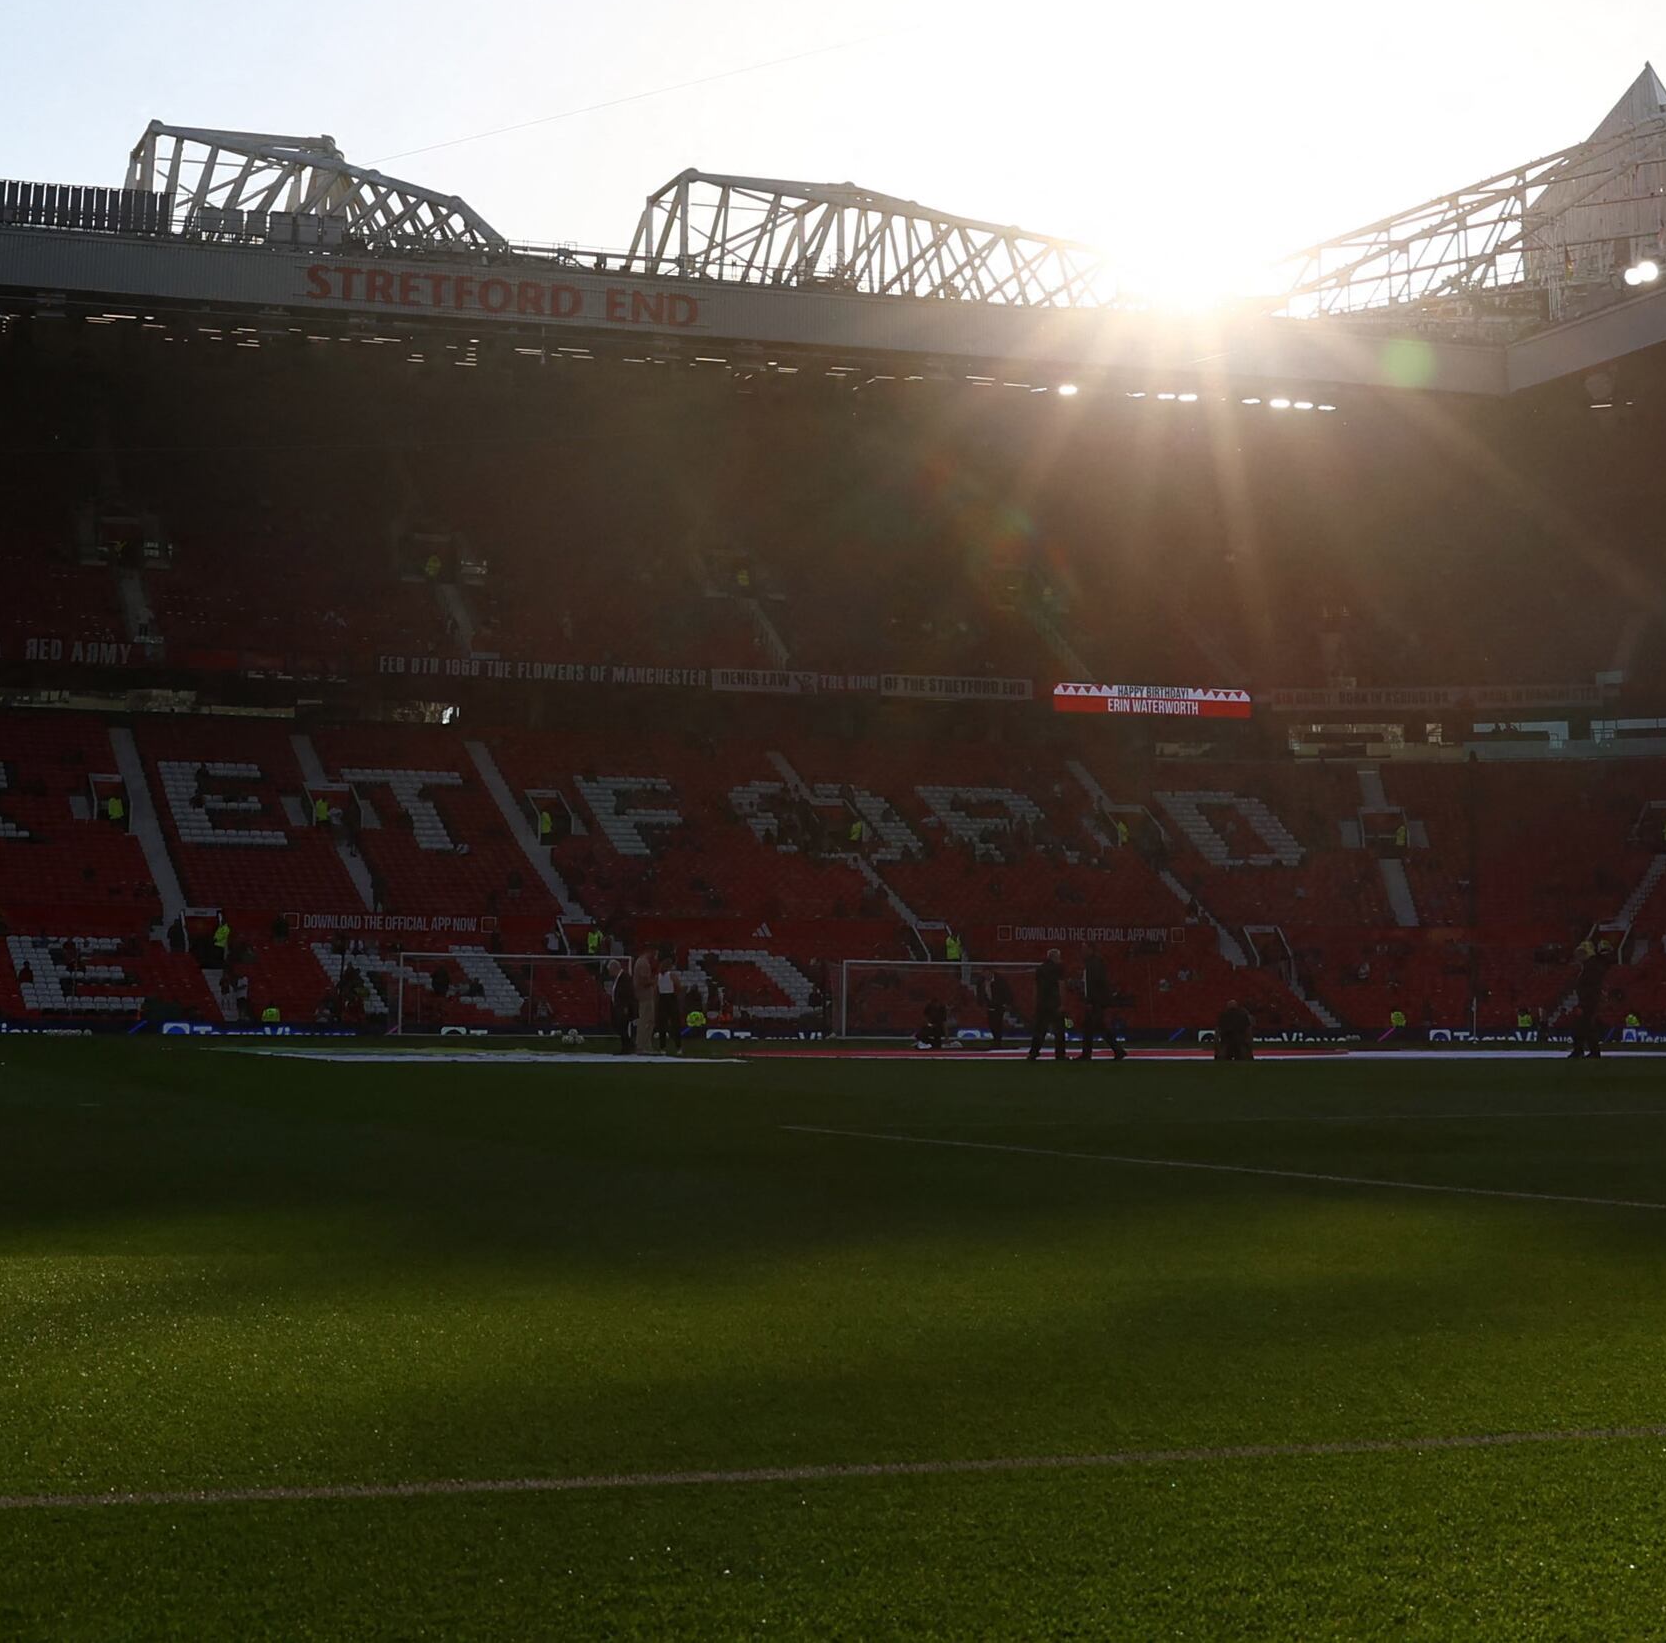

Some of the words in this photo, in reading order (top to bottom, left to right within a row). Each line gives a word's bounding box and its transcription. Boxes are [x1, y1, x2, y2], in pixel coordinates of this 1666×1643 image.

[306, 263, 584, 319] STRETFORD
[605, 287, 700, 328] END
[486, 659, 513, 679] THE
[517, 661, 585, 683] FLOWERS
[590, 665, 608, 684] OF
[612, 665, 707, 687] MANCHESTER
[1117, 685, 1144, 698] HAPPY
[1107, 698, 1131, 714] ERIN
[1131, 699, 1199, 716] WATERWORTH
[303, 913, 362, 929] DOWNLOAD
[364, 915, 383, 930] THE
[385, 916, 430, 932] OFFICIAL
[431, 916, 451, 932] APP
[453, 917, 477, 932] NOW
[1015, 926, 1066, 941] DOWNLOAD
[1068, 927, 1086, 942] THE
[1086, 927, 1126, 942] OFFICIAL
[1127, 928, 1145, 942] APP
